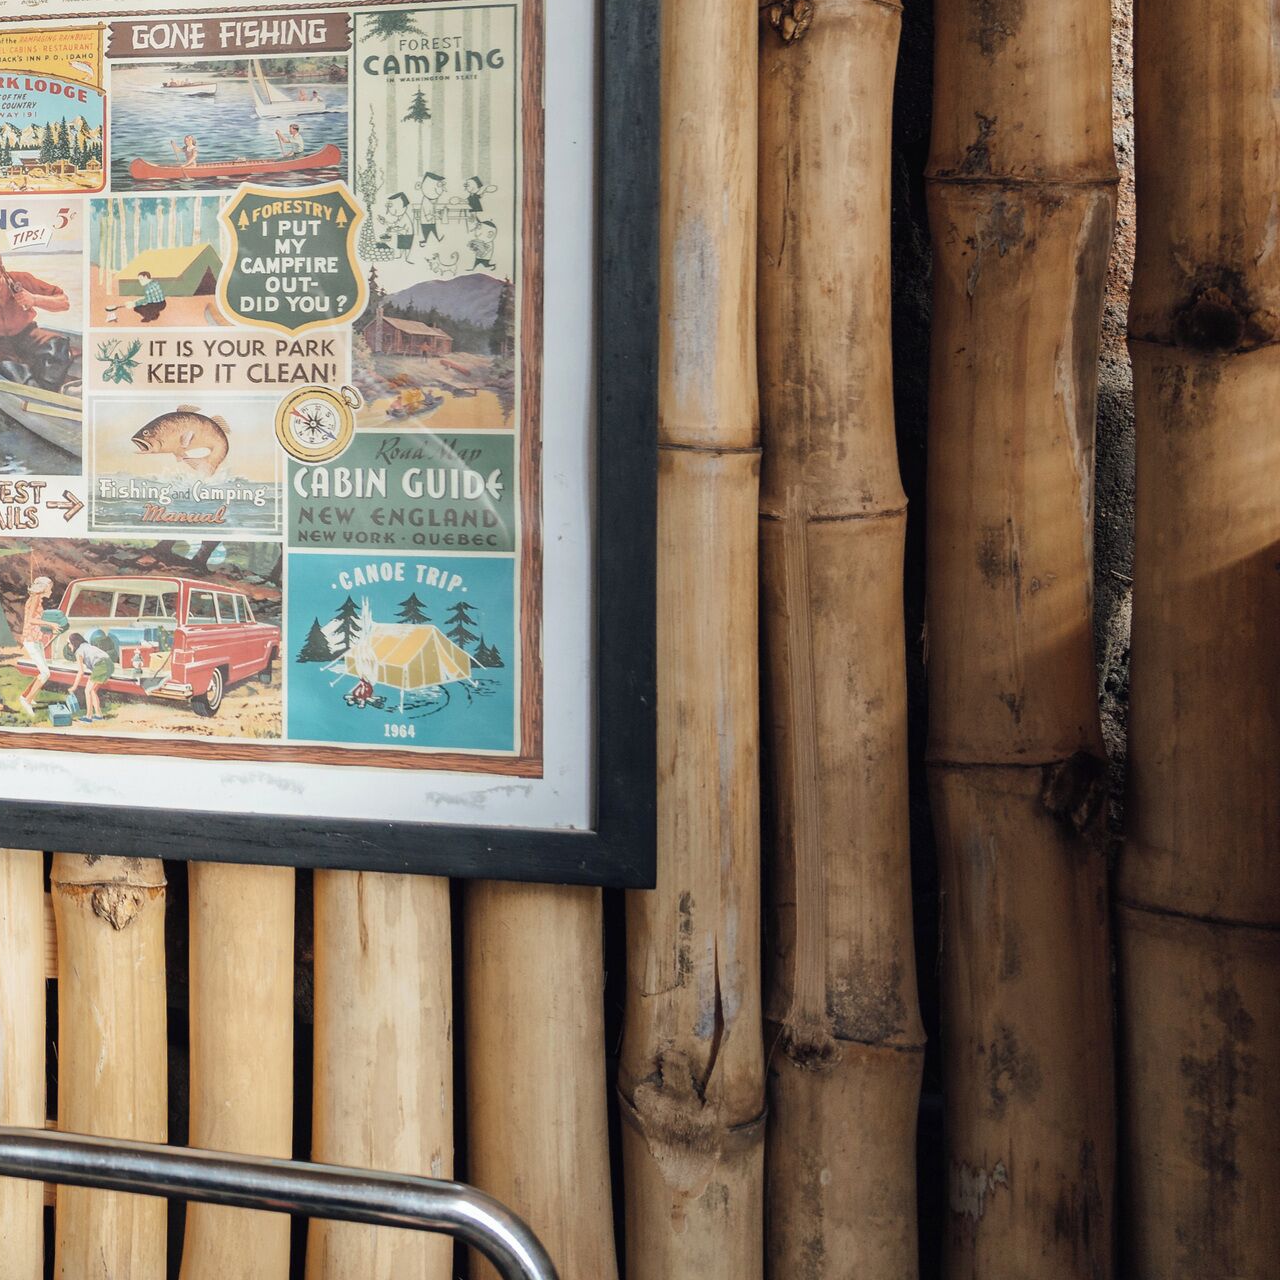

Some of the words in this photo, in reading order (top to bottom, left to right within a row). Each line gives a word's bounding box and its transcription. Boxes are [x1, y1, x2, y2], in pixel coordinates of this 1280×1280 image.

[131, 23, 205, 50] GONE
[219, 19, 327, 49] FISHING
[9, 45, 37, 53] CABINS
[43, 43, 93, 52] RESTAURANT
[399, 36, 463, 51] FOREST
[66, 52, 94, 60] IDAHO
[2, 93, 12, 101] OF
[25, 78, 88, 103] LODGE
[1, 101, 37, 110] COUNTRY
[53, 208, 77, 229] 5¢
[252, 200, 333, 222] FORESTRY
[13, 228, 45, 245] TIPS!
[262, 221, 268, 236] I
[279, 220, 321, 236] PUT
[275, 238, 307, 254] MY
[240, 257, 338, 274] CAMPFIRE
[265, 277, 318, 293] OUT-
[240, 296, 279, 313] DID
[285, 296, 330, 312] YOU
[149, 340, 167, 357] IT
[176, 340, 193, 357] IS
[203, 339, 265, 357] YOUR
[275, 339, 336, 357] PARK
[147, 364, 204, 384] KEEP
[215, 363, 237, 383] IT
[247, 363, 337, 384] CLEAN!
[293, 466, 388, 499] CABIN
[401, 467, 505, 501] GUIDE
[98, 478, 173, 505] Fishing
[172, 488, 190, 499] and
[192, 480, 268, 507] Camping
[141, 503, 228, 525] Manual
[298, 506, 356, 526] NEW
[370, 507, 500, 529] ENGLAND
[298, 530, 336, 543] NEW
[342, 531, 396, 544] YORK
[412, 533, 498, 547] QUEBEC
[339, 562, 405, 590] CANOE
[415, 564, 464, 592] TRIP
[384, 723, 416, 738] 1964
